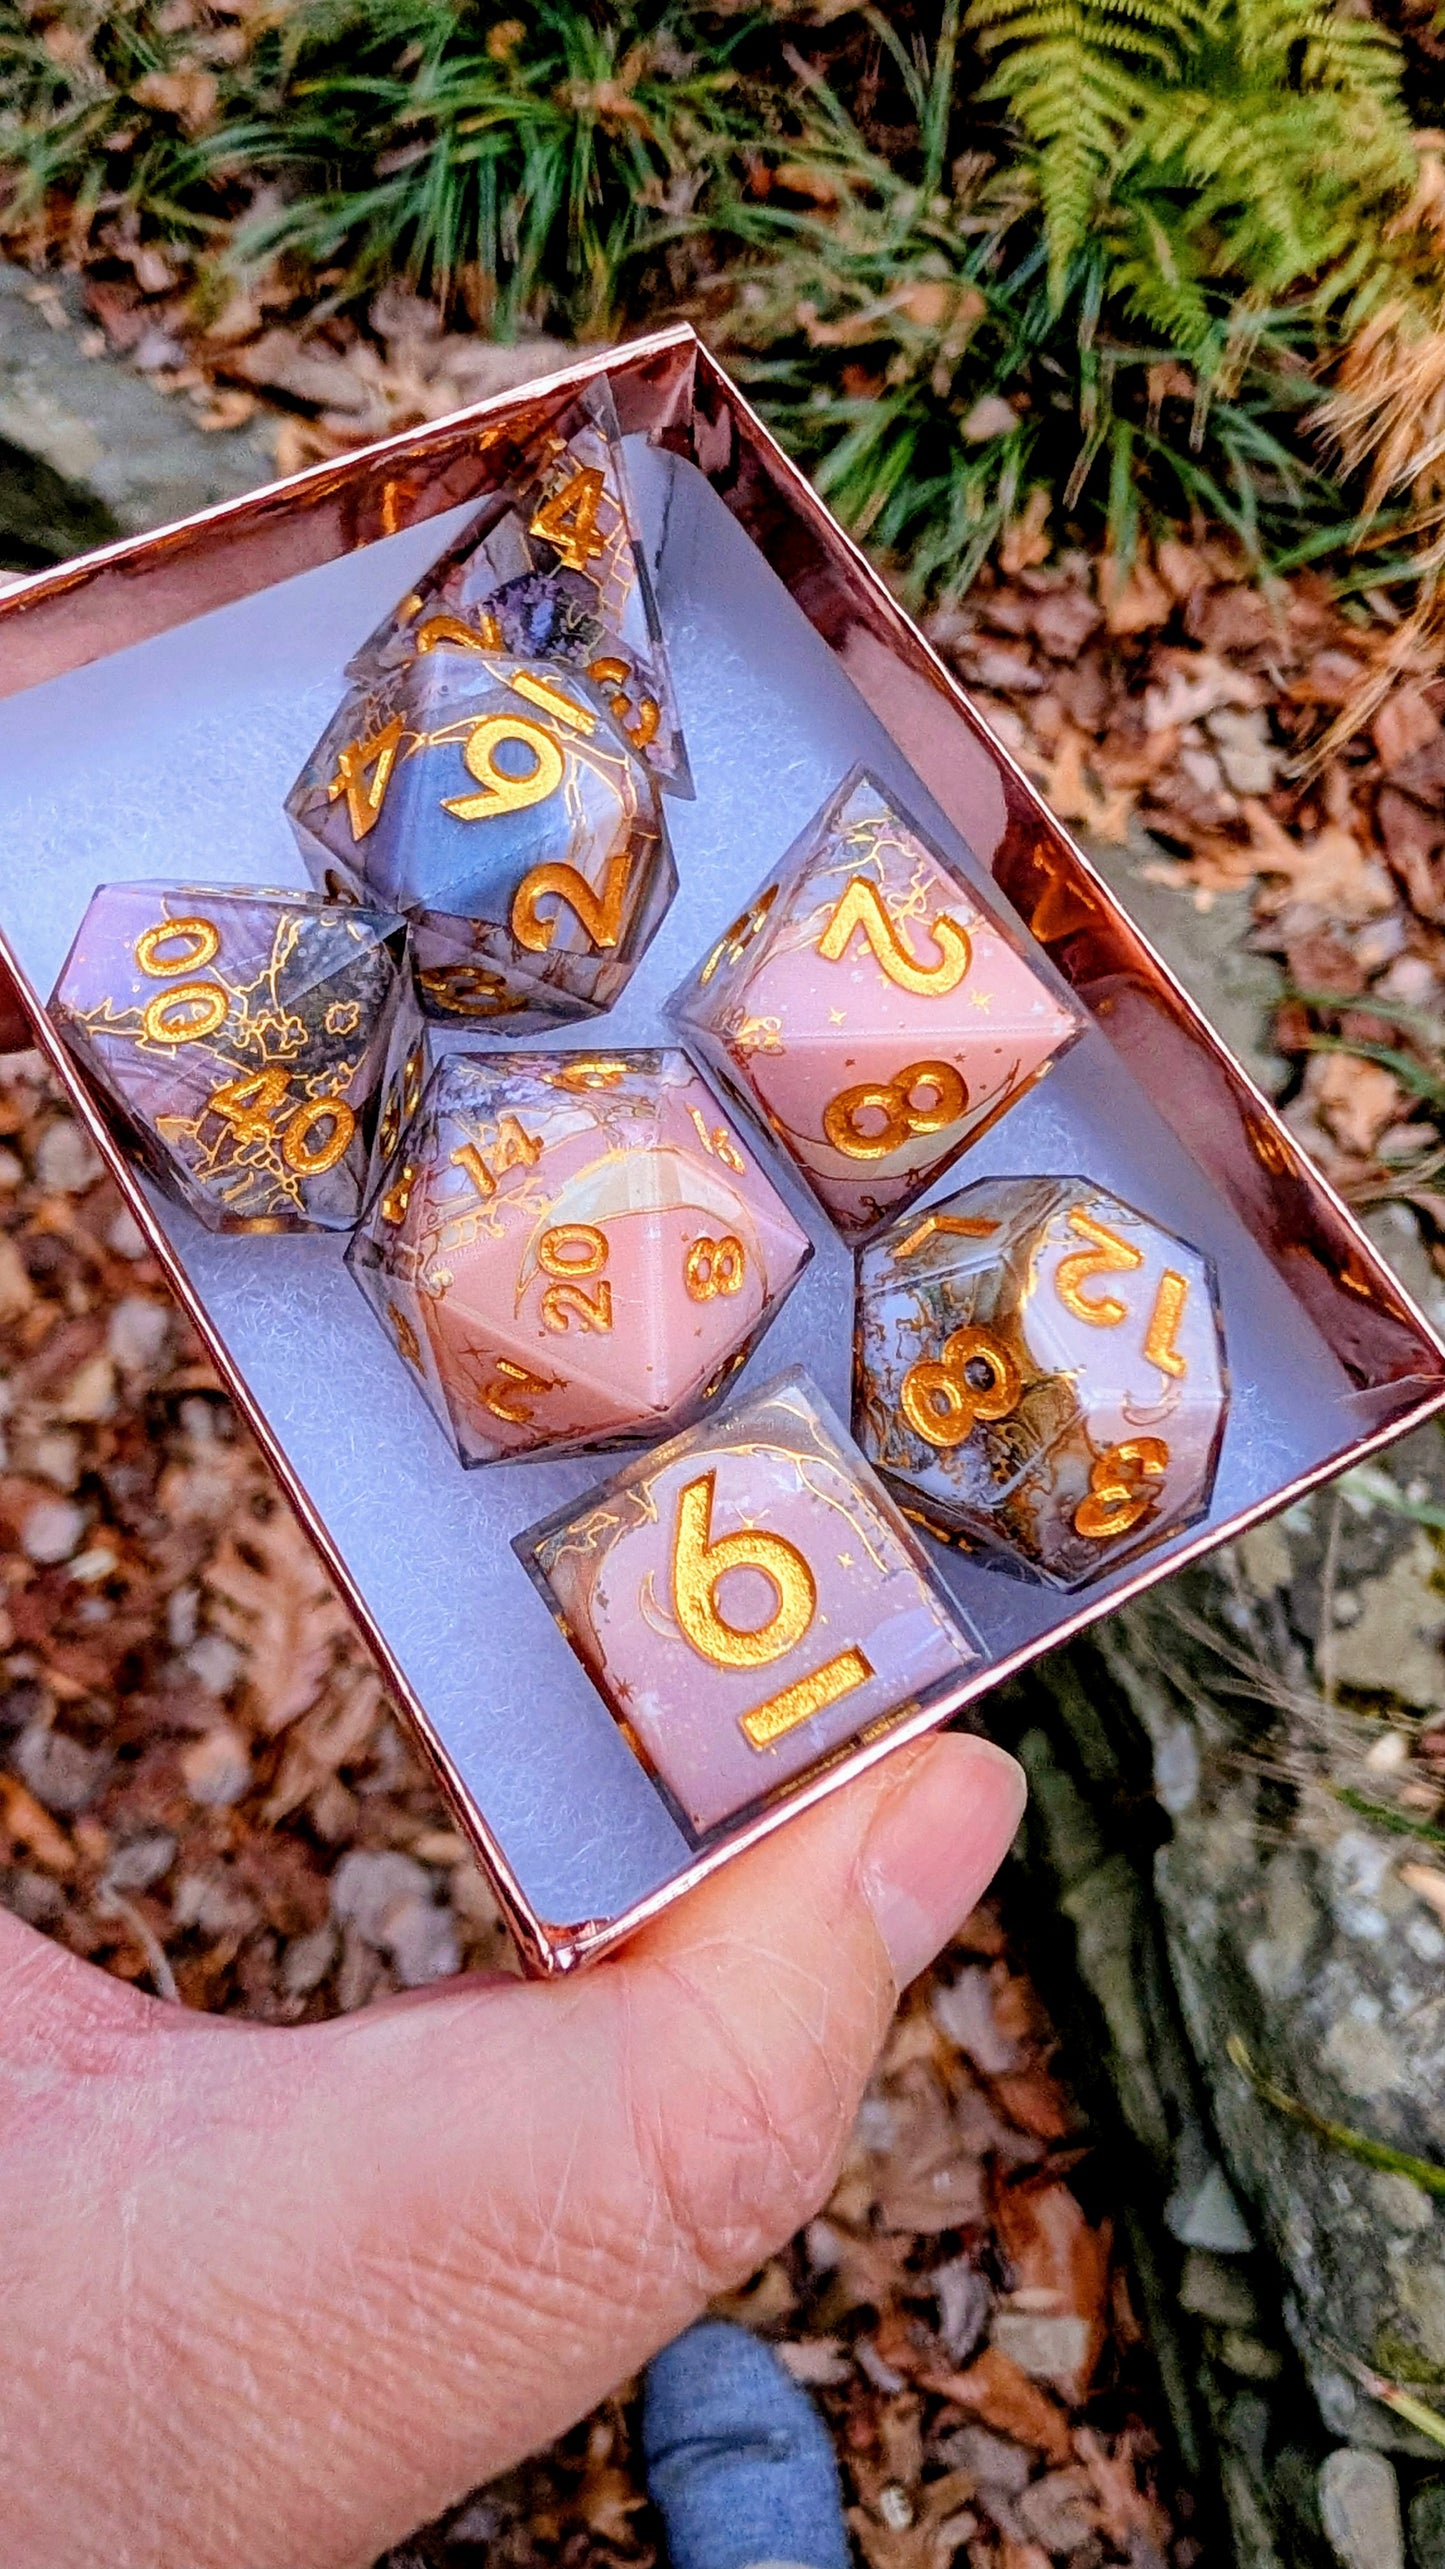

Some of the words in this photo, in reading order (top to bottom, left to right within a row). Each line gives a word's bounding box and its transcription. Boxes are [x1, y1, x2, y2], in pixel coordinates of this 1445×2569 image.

[530, 468, 606, 571] 4
[511, 852, 632, 952] 2
[210, 1065, 356, 1174] 40
[449, 1114, 545, 1197] 14
[823, 1060, 970, 1161] 8
[538, 1223, 614, 1334] 20
[685, 1235, 745, 1304] 8
[1054, 1205, 1190, 1379] 12
[901, 1324, 1021, 1447] 8
[672, 1467, 819, 1671] 6
